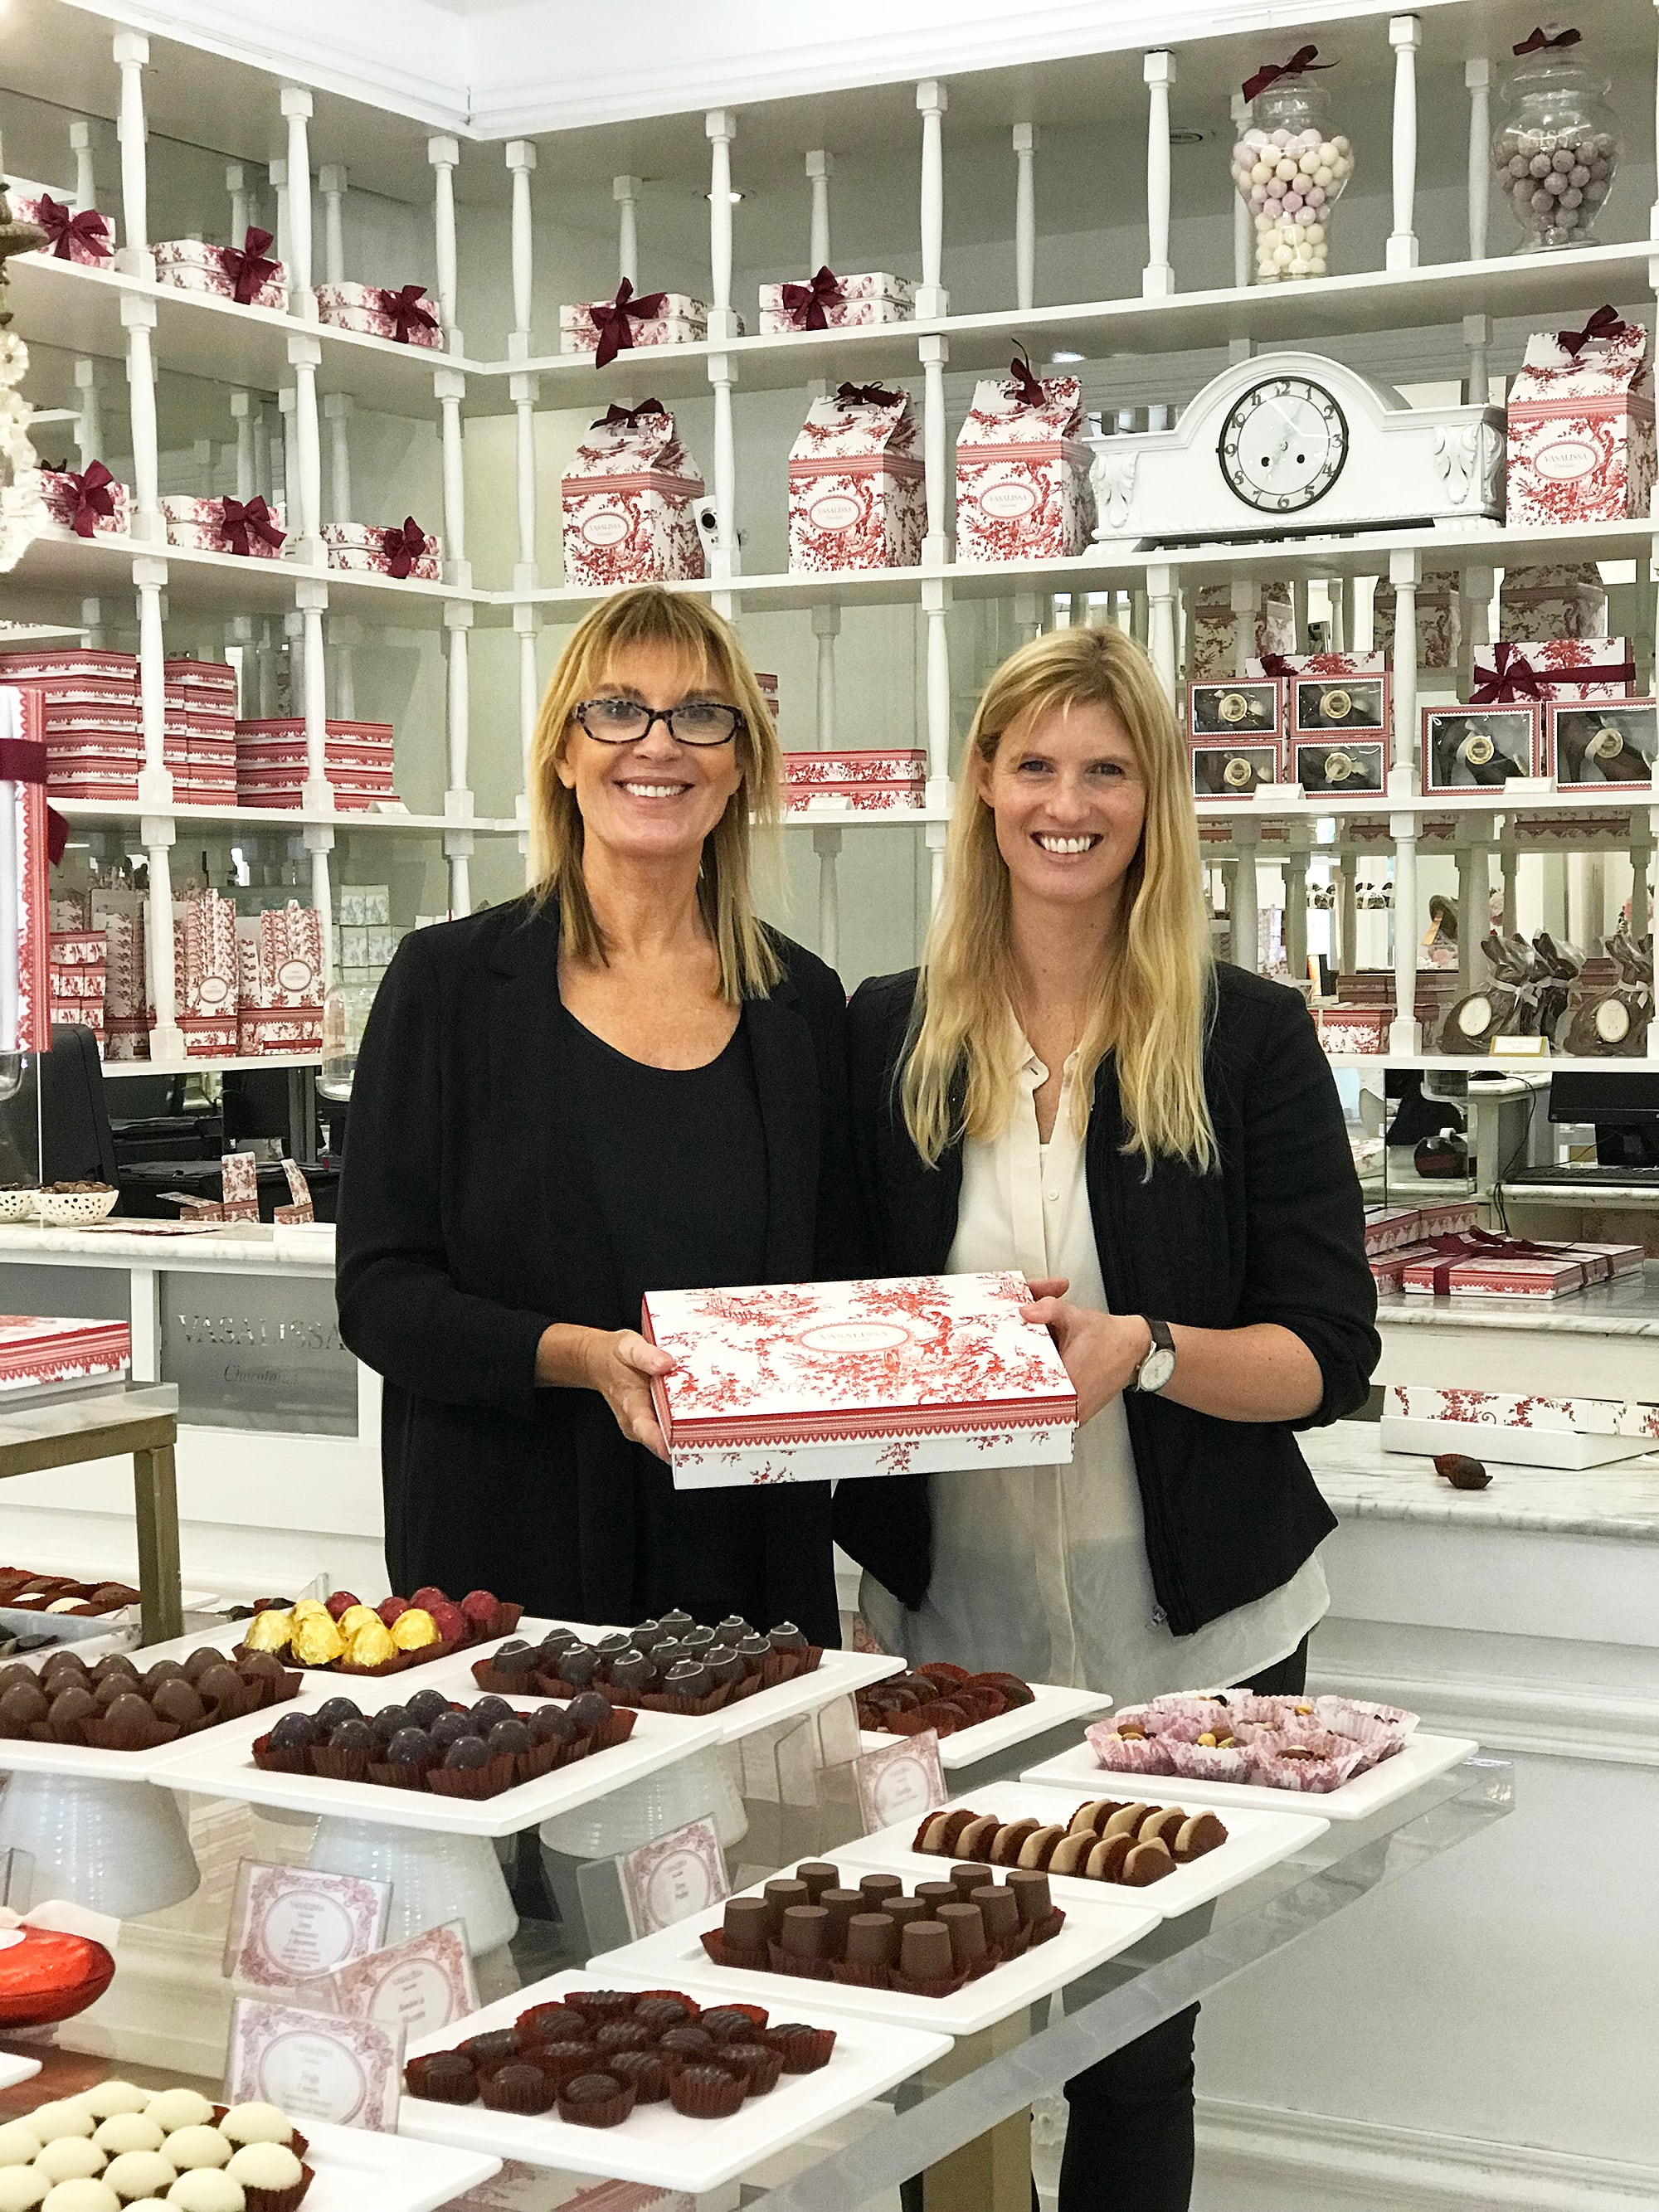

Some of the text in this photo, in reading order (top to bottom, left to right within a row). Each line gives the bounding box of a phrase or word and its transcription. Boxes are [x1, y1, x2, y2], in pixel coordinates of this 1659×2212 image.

[1276, 381, 1291, 396] 12
[1306, 386, 1312, 400] 1
[1323, 405, 1335, 420] 2
[1231, 413, 1245, 428] 10
[1331, 434, 1343, 448] 3
[1224, 444, 1238, 457] 9
[1545, 453, 1588, 462] VASALISSA
[1321, 463, 1335, 477] 4
[1233, 470, 1244, 485] 8
[1253, 489, 1262, 505] 7
[1305, 485, 1315, 499] 5
[1277, 494, 1290, 508] 6
[178, 1314, 346, 1350] VASALISSA
